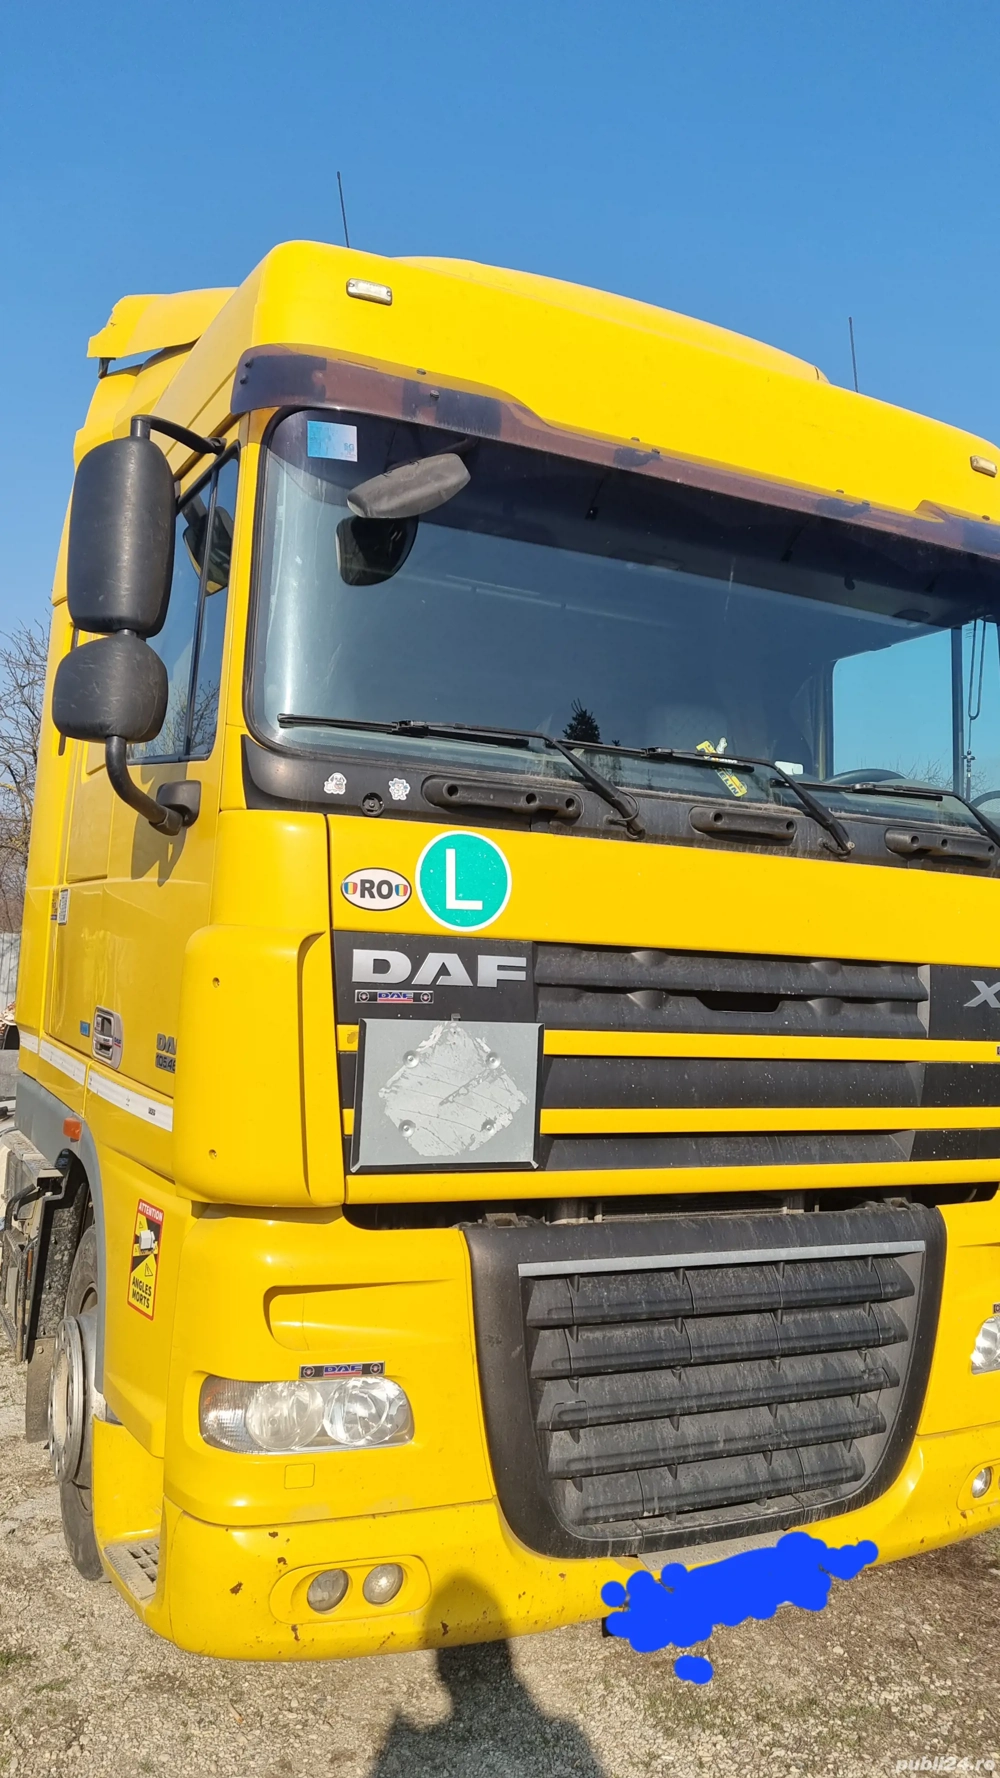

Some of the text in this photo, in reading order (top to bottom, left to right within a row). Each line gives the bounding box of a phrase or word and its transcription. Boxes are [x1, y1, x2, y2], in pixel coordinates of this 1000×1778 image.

[359, 878, 394, 900] RO
[445, 848, 483, 911] L
[352, 948, 527, 988] DAF
[377, 991, 414, 1000] DAF
[156, 1033, 177, 1055] DA
[138, 1201, 163, 1223] ATTENTION
[132, 1276, 152, 1298] ANGLES
[131, 1291, 150, 1309] MORTS
[324, 1363, 363, 1373] DAF
